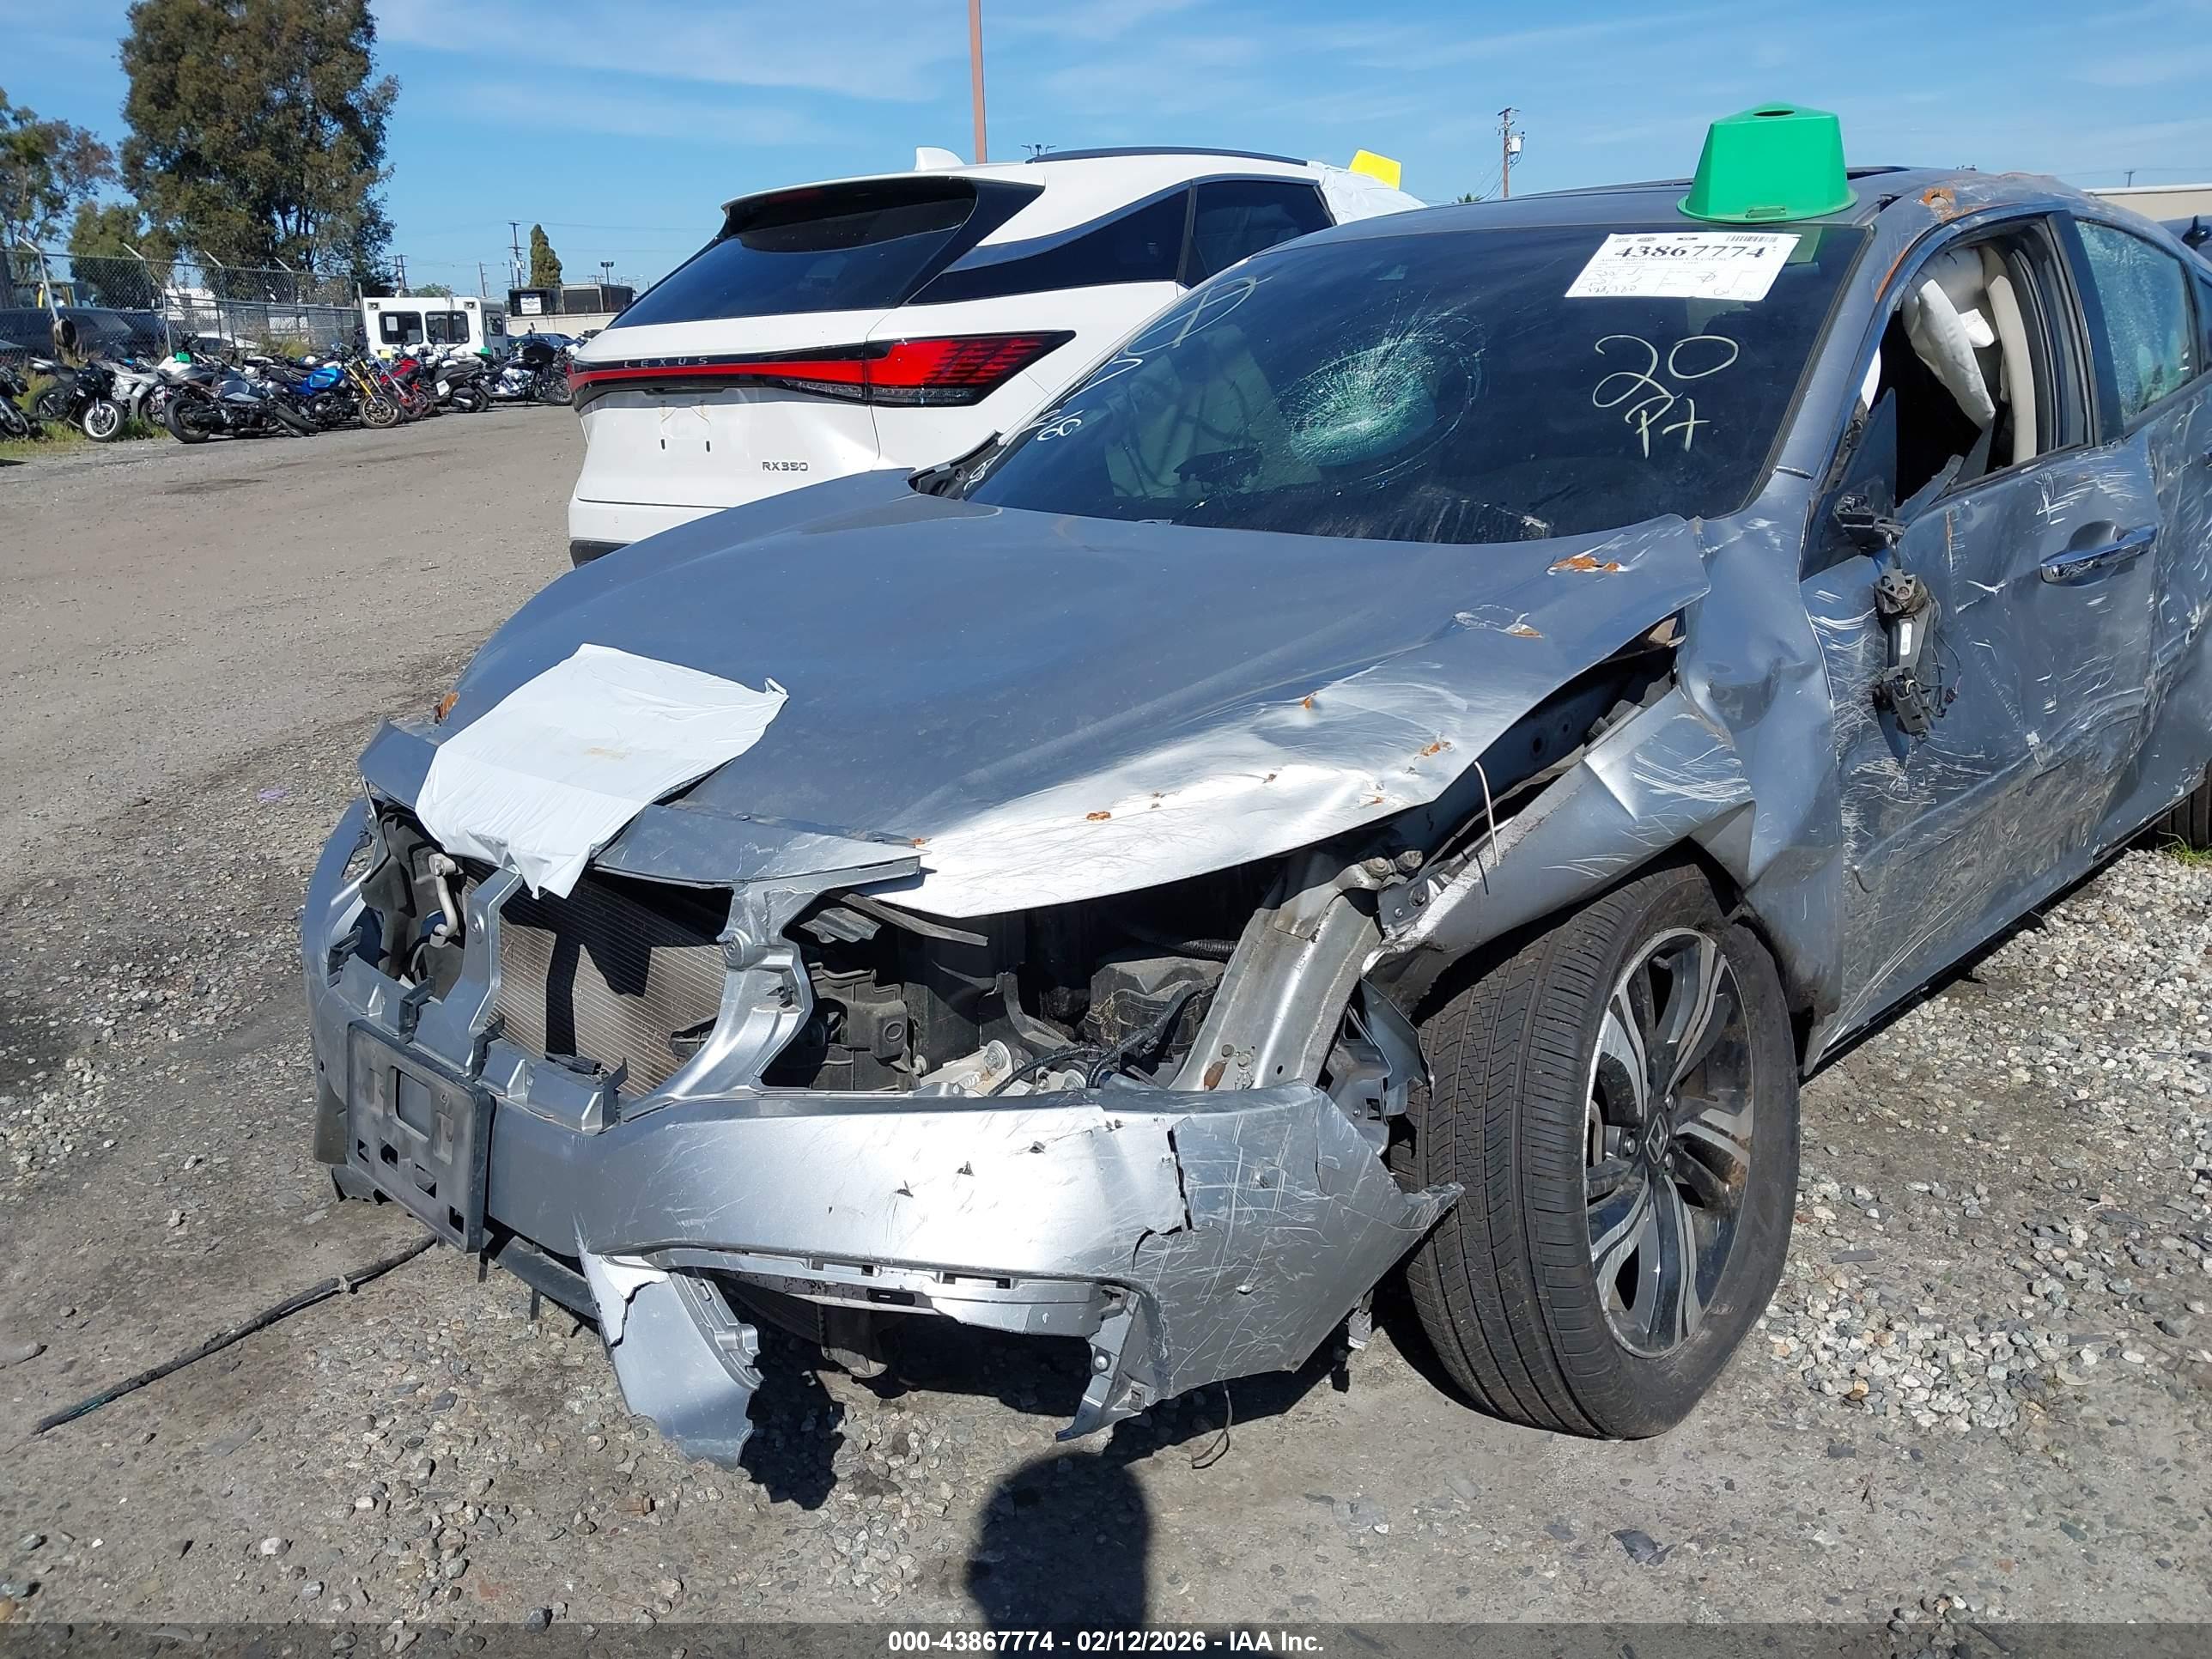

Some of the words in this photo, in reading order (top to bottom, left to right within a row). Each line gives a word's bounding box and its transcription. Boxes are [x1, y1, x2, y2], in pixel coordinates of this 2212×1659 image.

[1614, 244, 1766, 258] 43867774
[623, 356, 709, 369] LEXUS
[1592, 334, 1740, 408] 20
[762, 461, 810, 471] RX350
